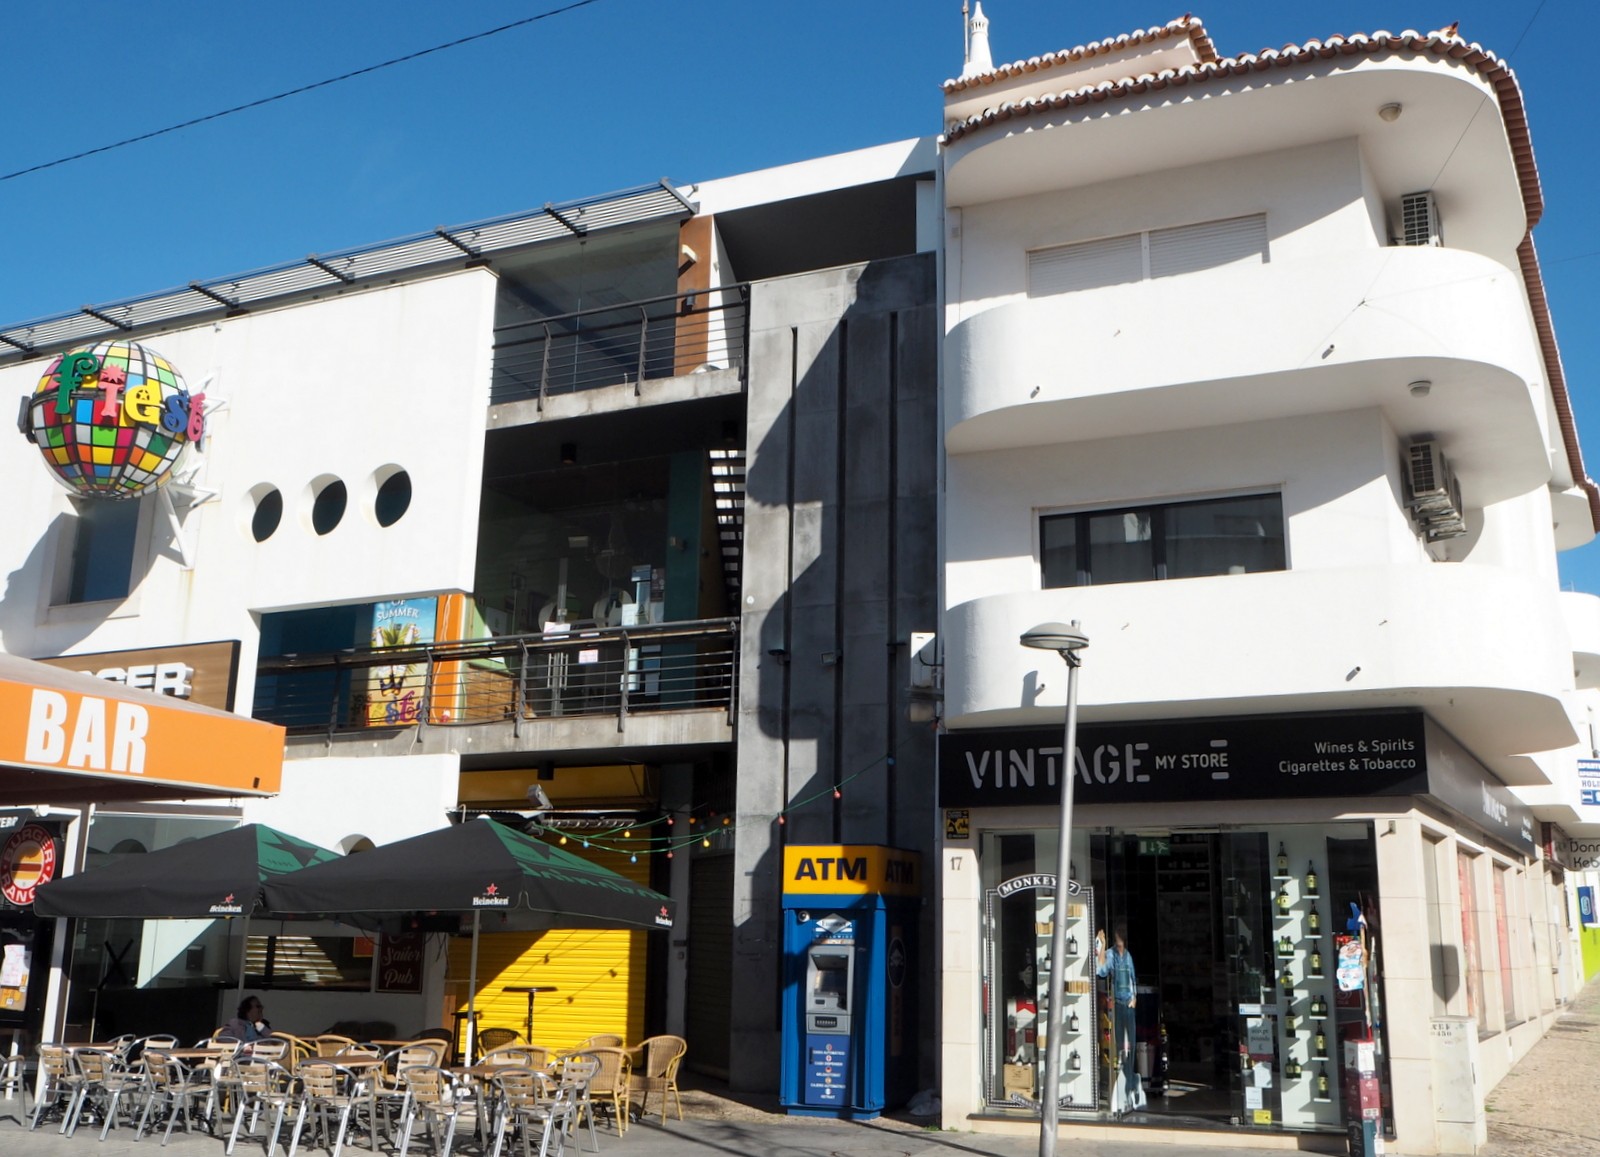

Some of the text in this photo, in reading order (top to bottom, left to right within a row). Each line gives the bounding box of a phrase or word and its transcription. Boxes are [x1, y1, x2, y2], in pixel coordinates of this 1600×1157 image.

[376, 607, 420, 620] SUMMER
[24, 688, 150, 774] BAR
[1314, 738, 1415, 754] Wines & Spirits
[1155, 753, 1229, 770] MY STORE
[1279, 758, 1416, 775] Cigarettes & Tobacco
[3, 827, 54, 864] BURGER
[794, 858, 868, 881] ATM
[885, 858, 914, 885] ATM
[950, 856, 963, 871] 17
[209, 904, 242, 913] Heineken
[472, 896, 510, 905] Heineken
[384, 968, 415, 988] Pub
